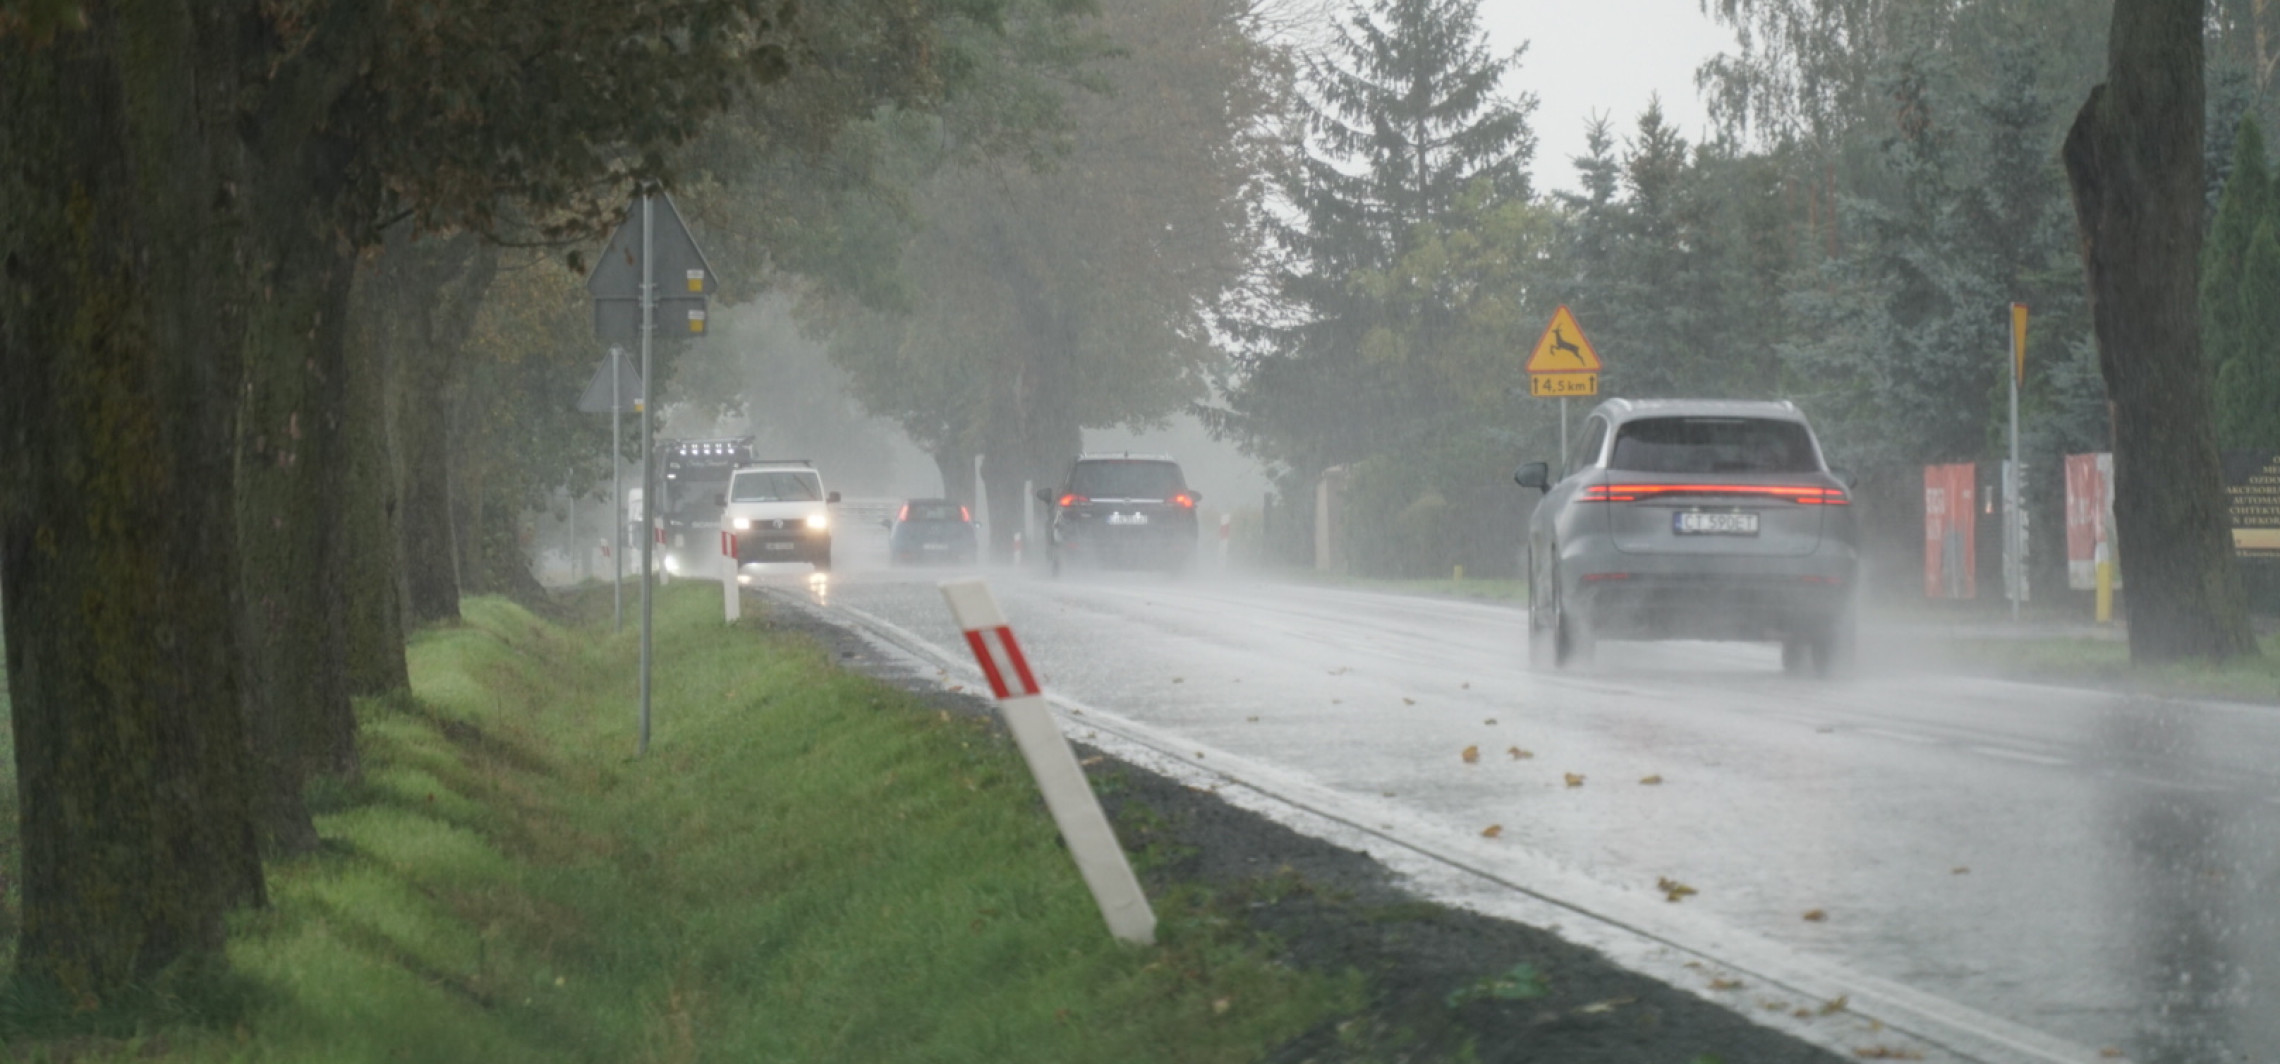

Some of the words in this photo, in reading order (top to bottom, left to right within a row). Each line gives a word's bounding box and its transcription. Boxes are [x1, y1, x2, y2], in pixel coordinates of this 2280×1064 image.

[1542, 378, 1565, 393] 4,5
[1567, 380, 1586, 392] km
[2226, 486, 2280, 494] AKCESORI
